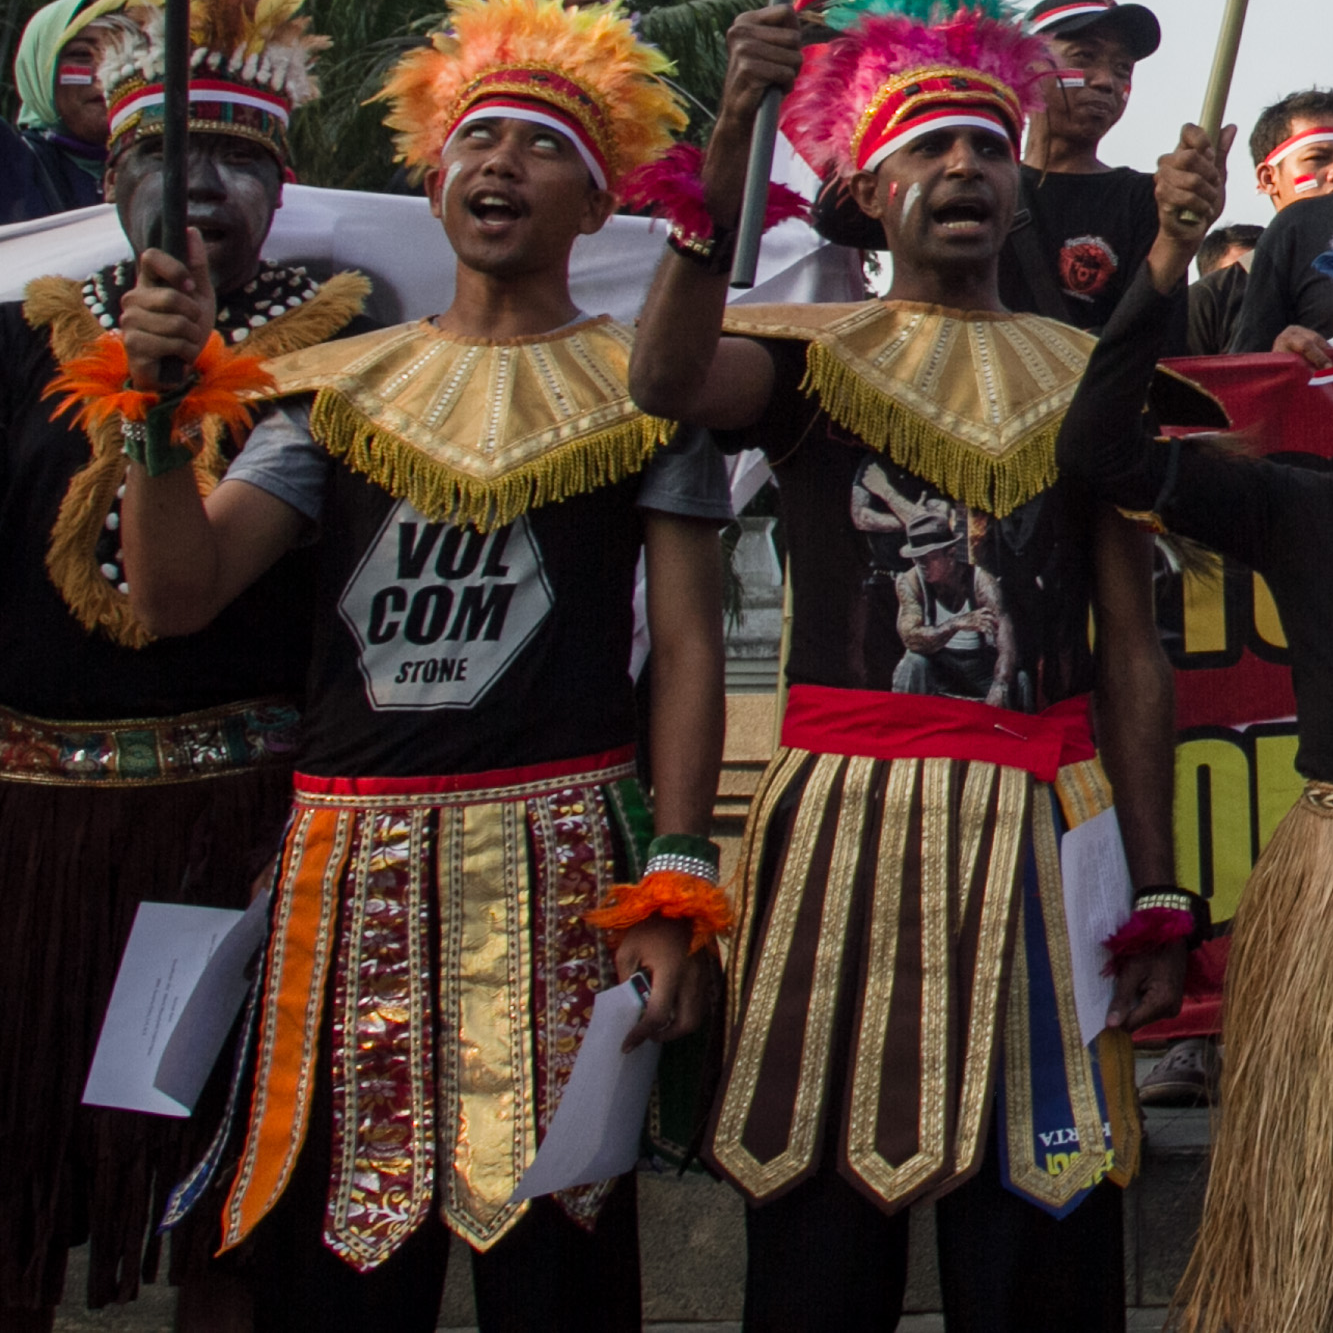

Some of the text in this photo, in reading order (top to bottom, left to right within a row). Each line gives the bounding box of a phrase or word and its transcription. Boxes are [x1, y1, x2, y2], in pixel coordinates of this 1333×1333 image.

[397, 521, 516, 580] VOL
[366, 583, 518, 646] COM
[394, 657, 469, 684] STONE
